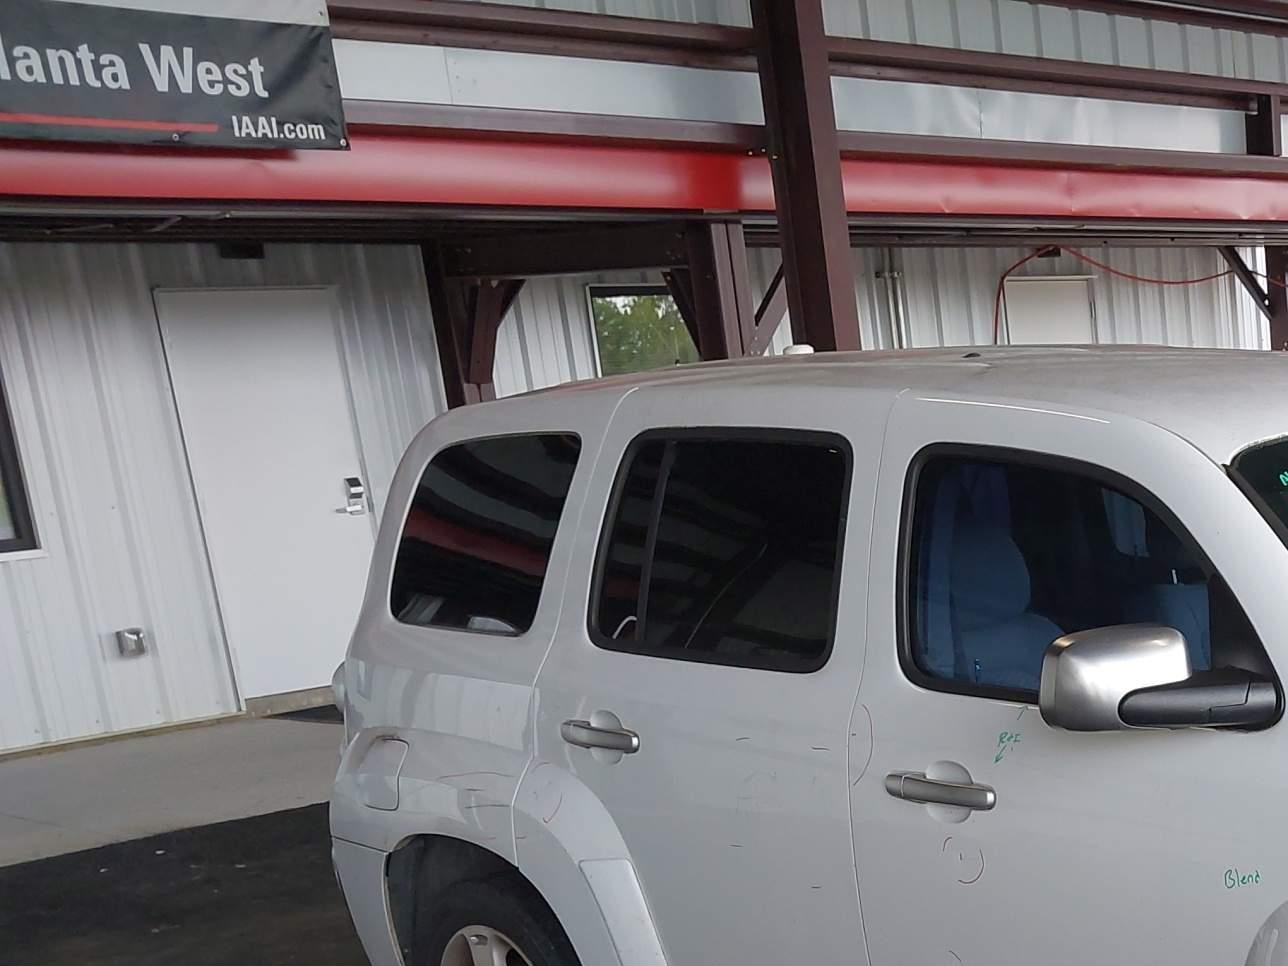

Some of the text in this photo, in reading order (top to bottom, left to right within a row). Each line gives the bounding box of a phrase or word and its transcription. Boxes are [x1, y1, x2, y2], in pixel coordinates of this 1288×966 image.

[138, 43, 270, 99] West
[231, 114, 327, 141] IAAI.com
[1224, 867, 1261, 889] Blend
